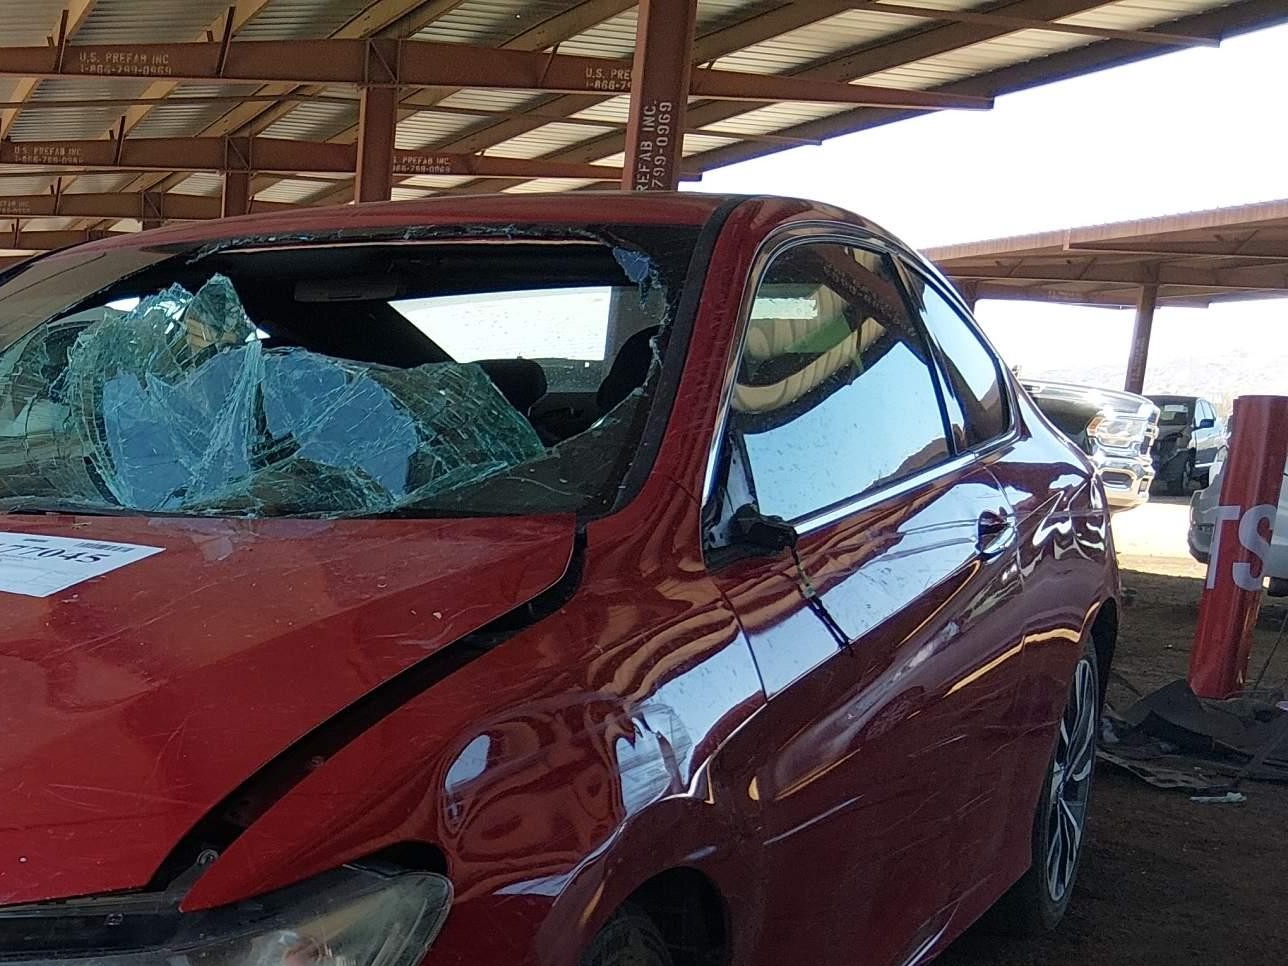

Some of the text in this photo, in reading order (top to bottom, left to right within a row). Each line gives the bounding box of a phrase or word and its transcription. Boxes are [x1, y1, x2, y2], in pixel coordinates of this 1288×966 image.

[105, 52, 147, 64] PREFAB
[585, 66, 632, 80] U.S. PRE
[636, 100, 657, 192] REFAB INC.
[652, 101, 672, 188] 799-0969
